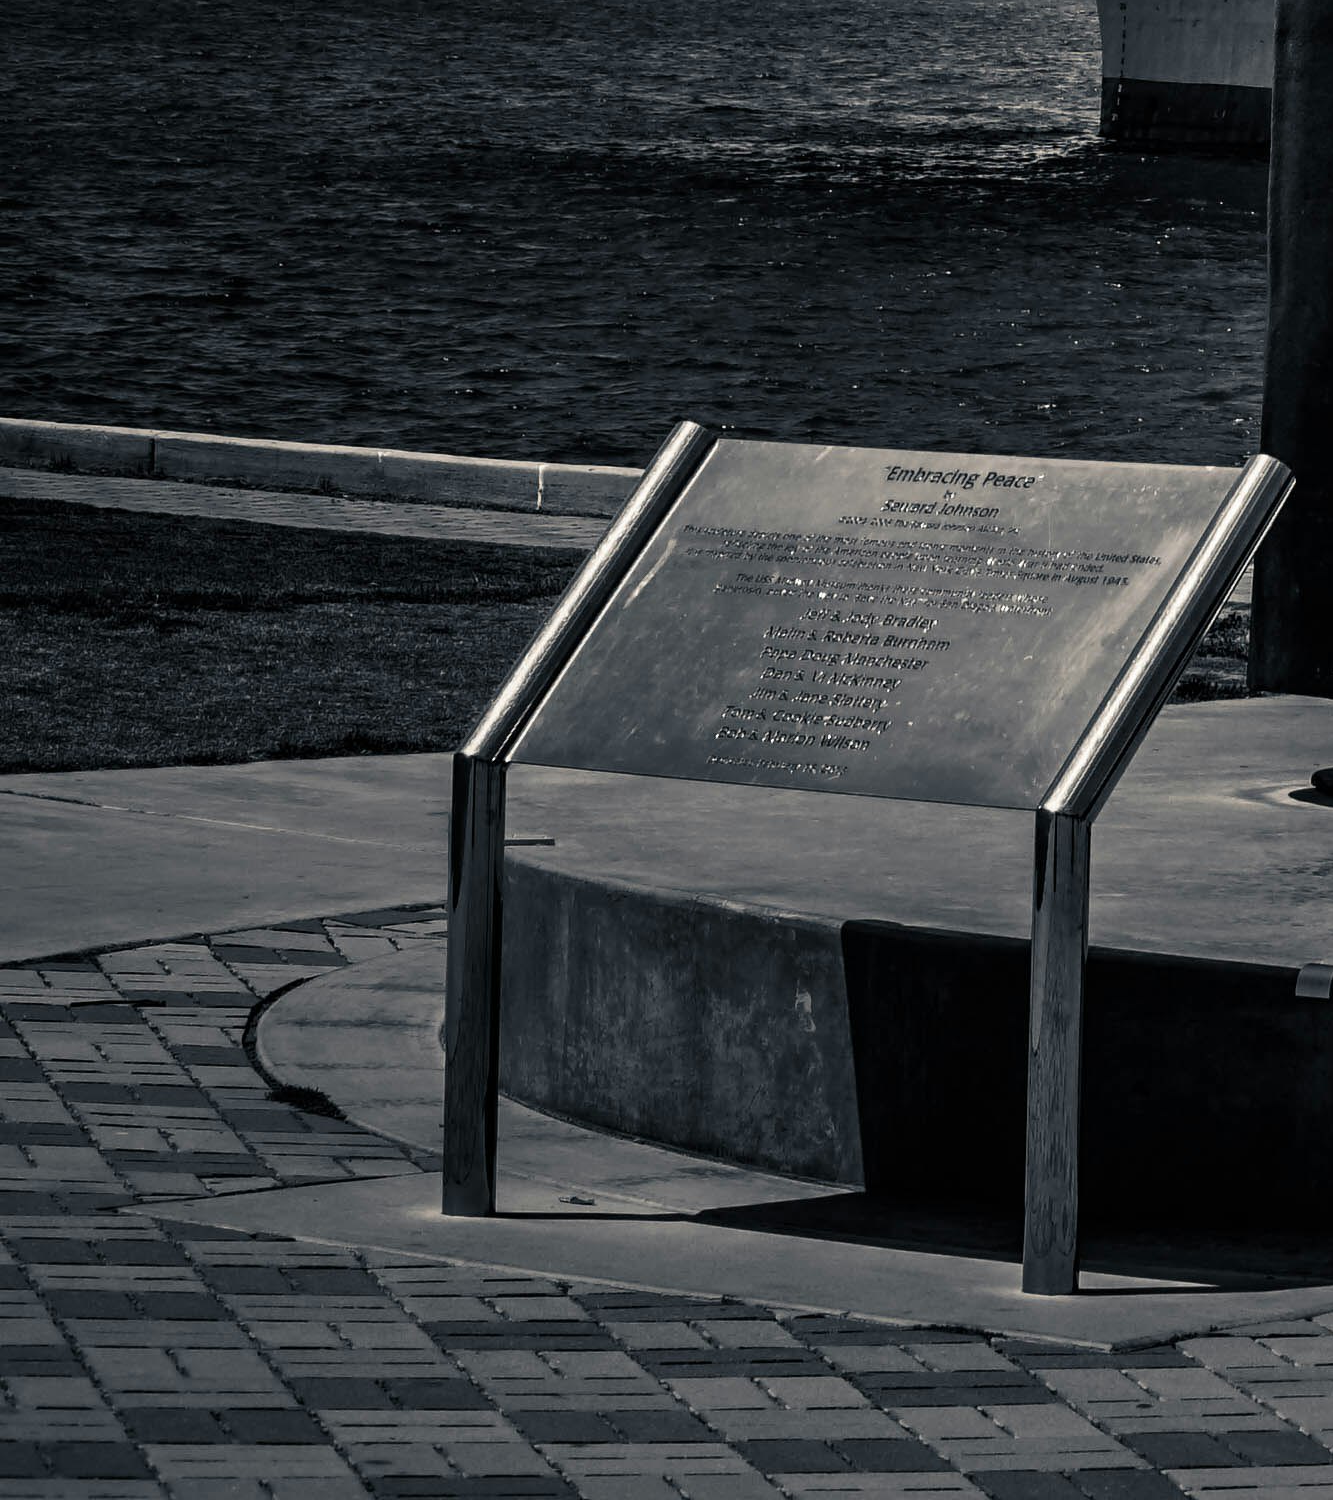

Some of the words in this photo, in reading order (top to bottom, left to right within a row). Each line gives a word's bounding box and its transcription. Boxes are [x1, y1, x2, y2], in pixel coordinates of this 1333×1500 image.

[880, 500, 936, 514] Seward
[936, 503, 999, 518] Johnson
[766, 542, 783, 550] the
[834, 545, 878, 557] American
[835, 535, 857, 545] most
[897, 540, 918, 548] and
[1095, 551, 1128, 563] United
[1129, 553, 1162, 566] States,
[736, 573, 754, 583] The
[755, 574, 774, 584] USS
[758, 552, 774, 562] the
[1064, 573, 1100, 587] August
[799, 607, 830, 621] Jeff
[830, 609, 842, 622] &
[842, 610, 880, 629] Jody
[880, 613, 940, 633] Bradley
[763, 625, 806, 639] Malin
[807, 628, 818, 642] &
[820, 629, 880, 646] Roberta
[882, 634, 951, 651] Burnham
[760, 645, 797, 662] Papa
[798, 648, 841, 667] Doug
[841, 652, 931, 671] Manchester
[760, 666, 793, 680] Dan
[793, 668, 806, 683] &
[827, 670, 903, 693] McKinney
[749, 686, 777, 700] Jim
[777, 688, 789, 703] &
[791, 690, 829, 706] Jane
[829, 692, 888, 714] Slattery
[720, 704, 754, 720] Tom
[754, 707, 768, 722] &
[771, 709, 825, 727] Cookie
[714, 725, 747, 740] Bob
[747, 728, 759, 742] &
[761, 730, 817, 747] Marion
[819, 733, 872, 751] Wilson
